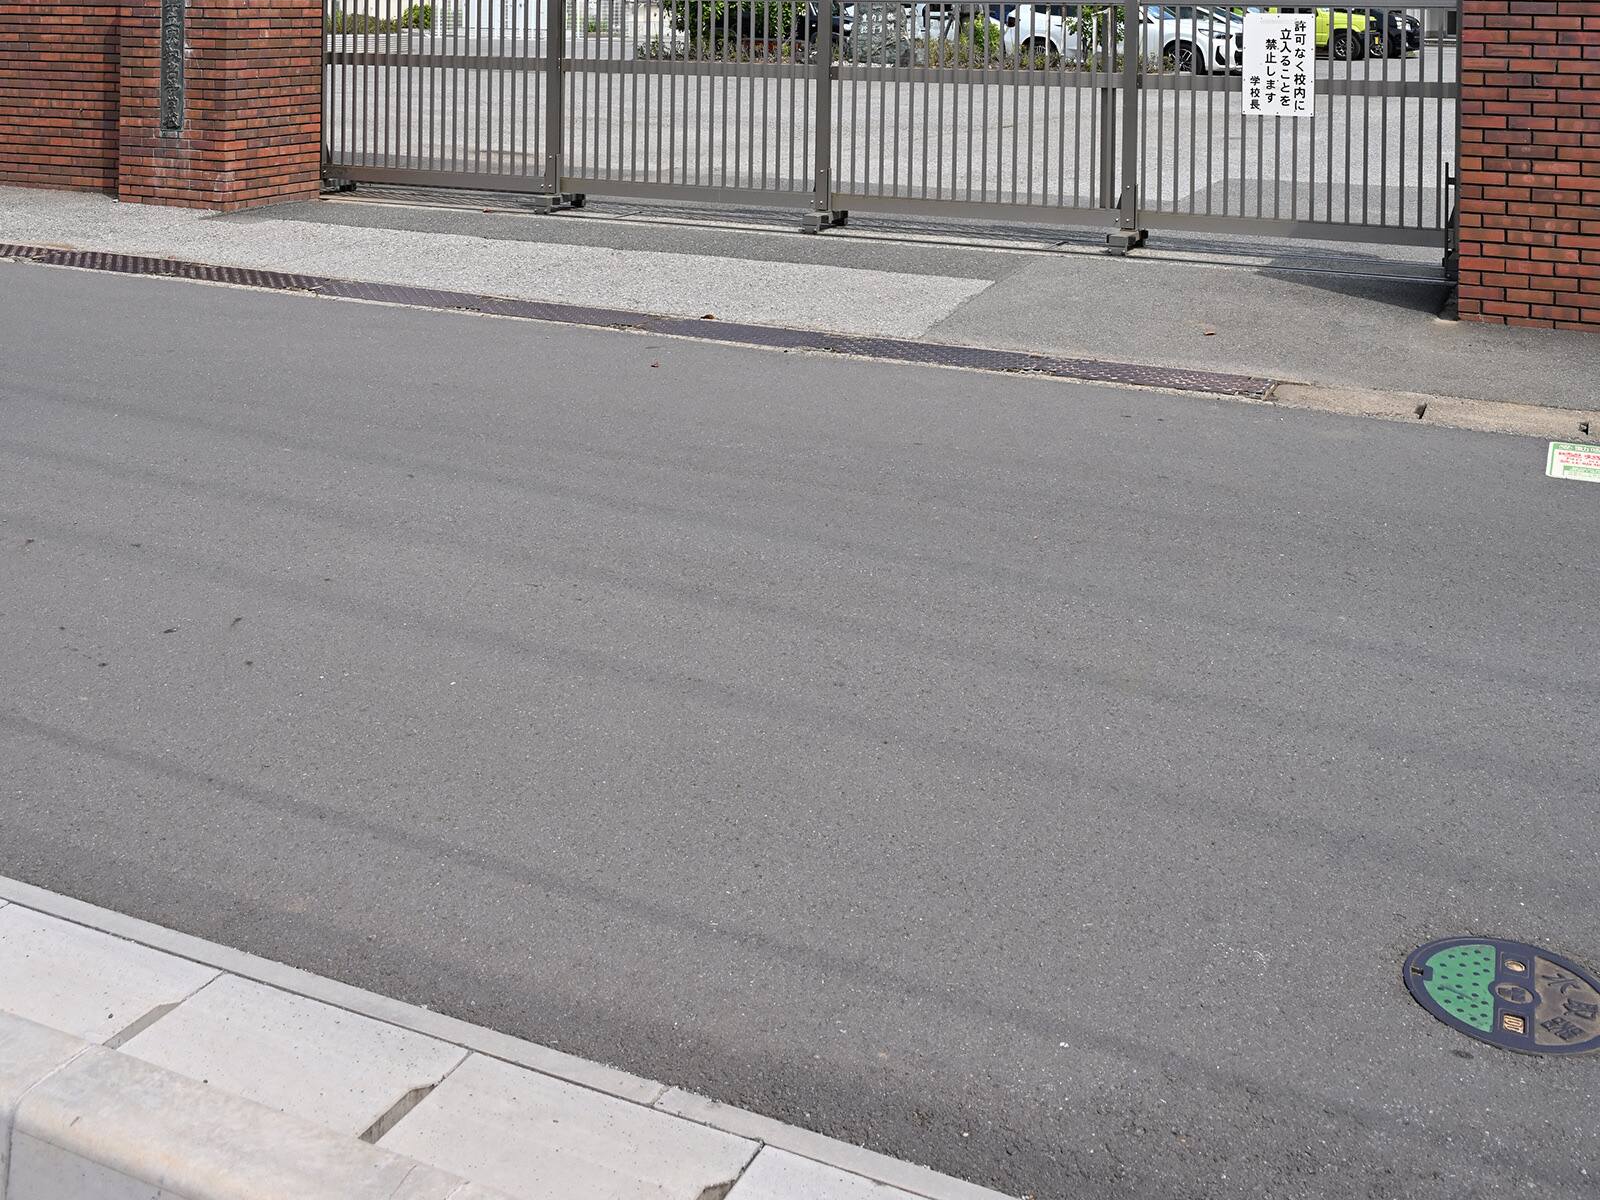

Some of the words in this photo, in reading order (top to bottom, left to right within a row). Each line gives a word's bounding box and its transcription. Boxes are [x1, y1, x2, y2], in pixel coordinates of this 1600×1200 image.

[1250, 75, 1261, 110] 学校長
[1265, 38, 1277, 103] 禁止します
[1280, 28, 1292, 107] 立入ることを
[1294, 20, 1306, 111] 許可なく校内に
